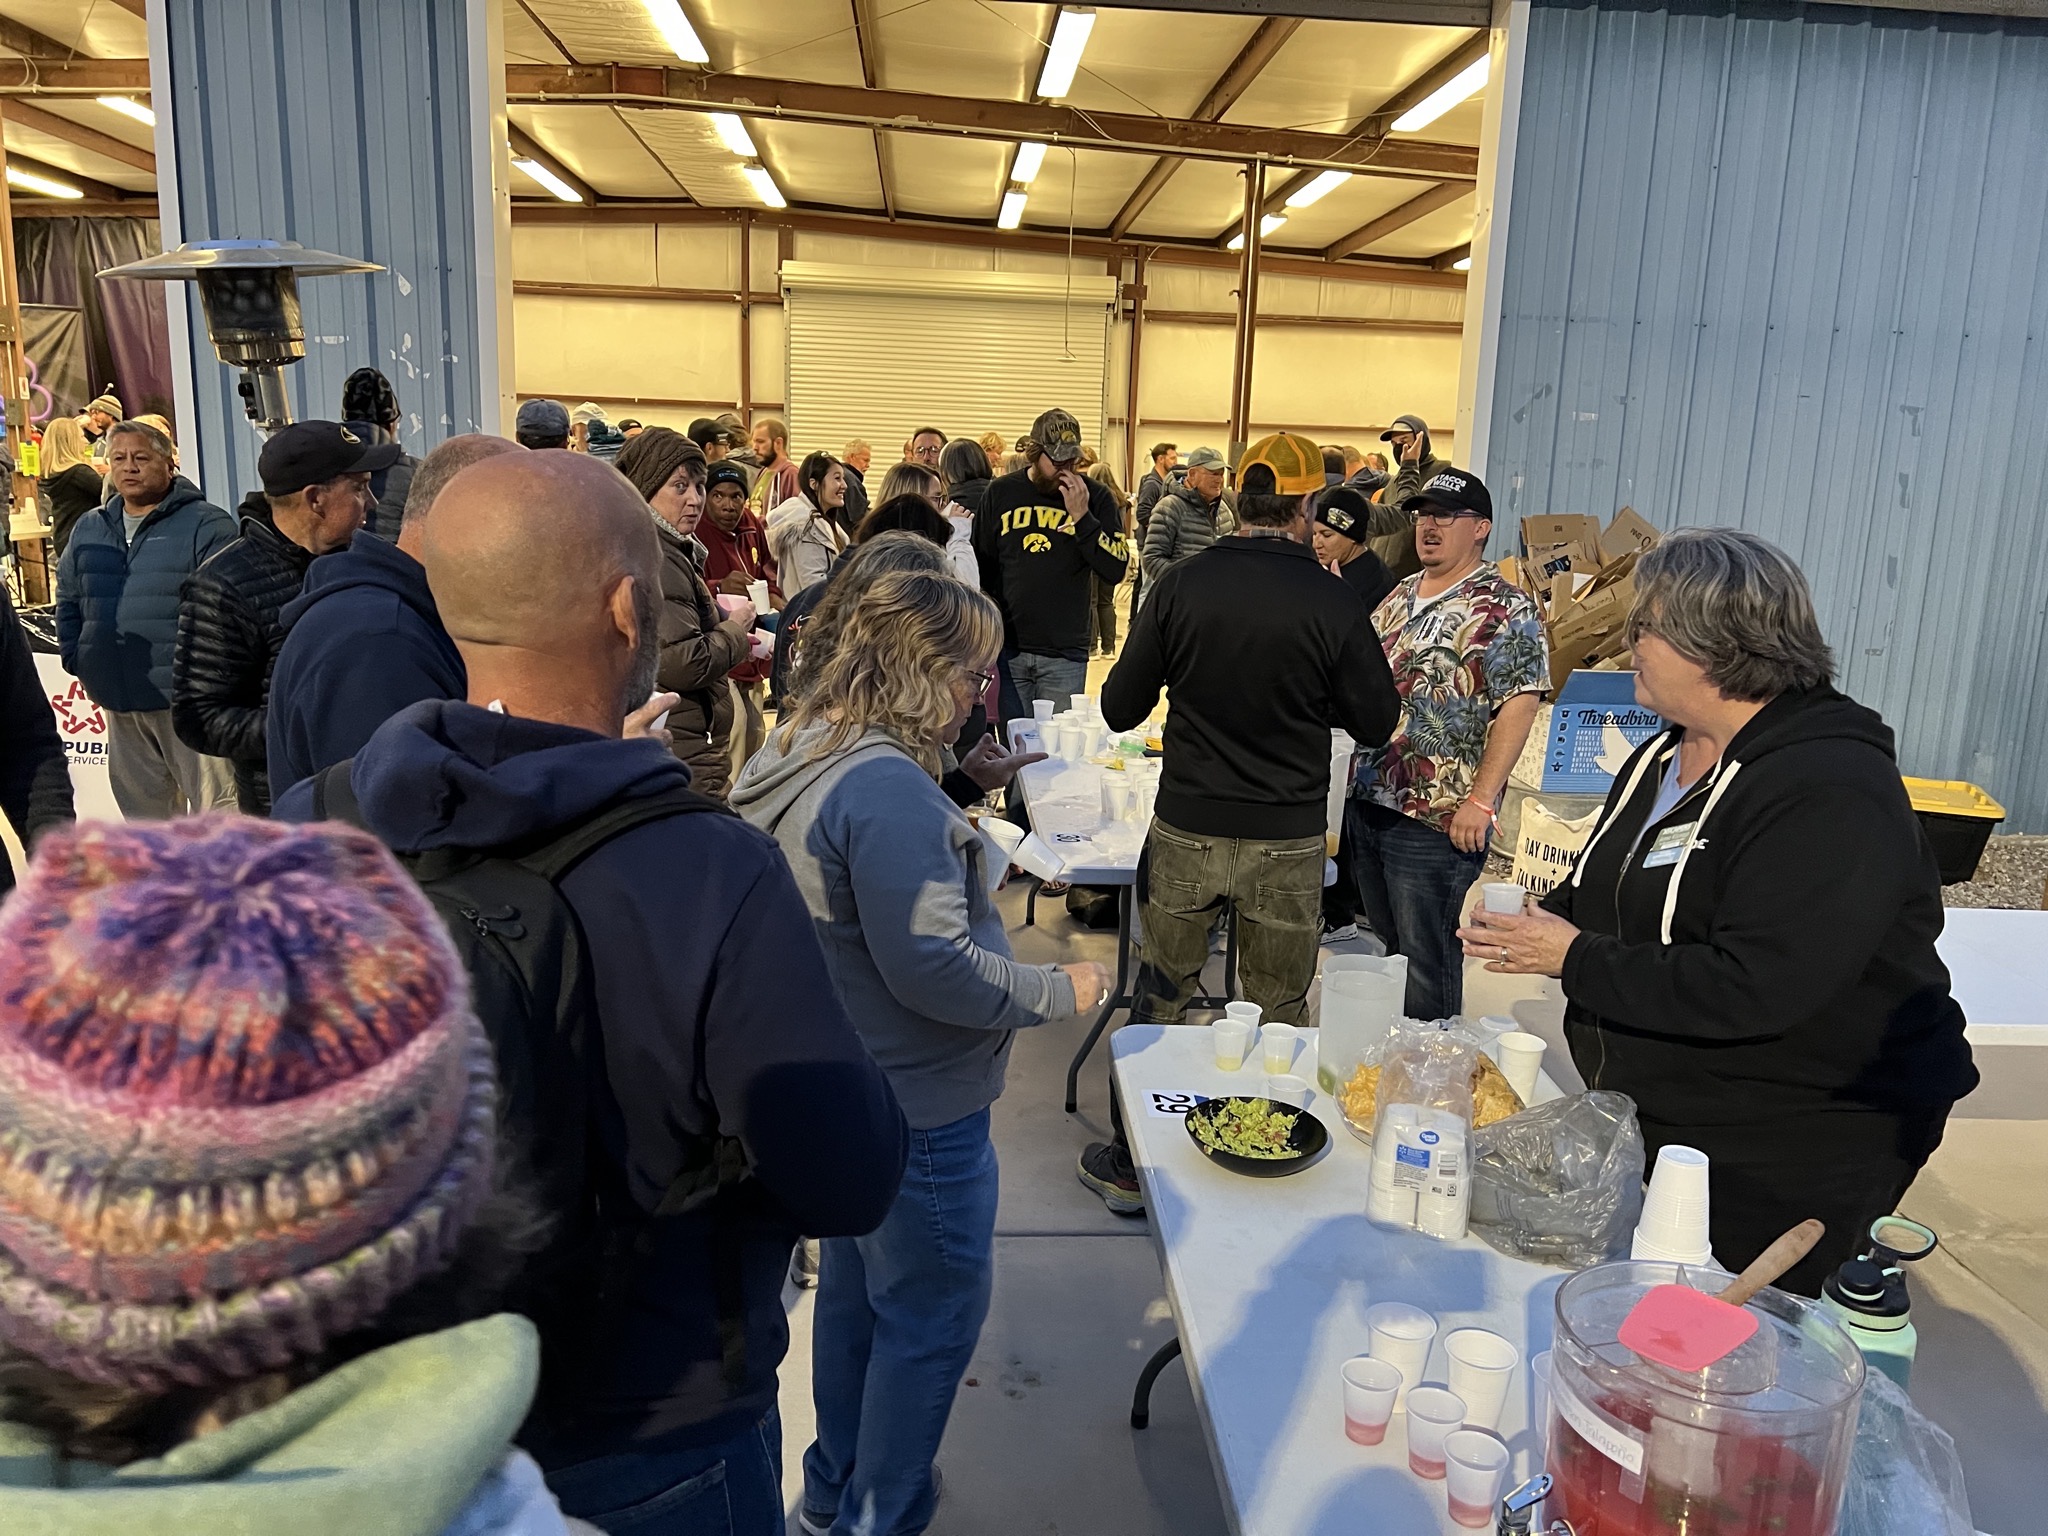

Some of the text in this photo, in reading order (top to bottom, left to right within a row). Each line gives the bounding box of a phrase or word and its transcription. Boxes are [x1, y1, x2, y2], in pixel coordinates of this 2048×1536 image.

[1578, 708, 1659, 727] Threadbird
[1525, 837, 1541, 858] DAY
[1152, 1093, 1193, 1114] 29
